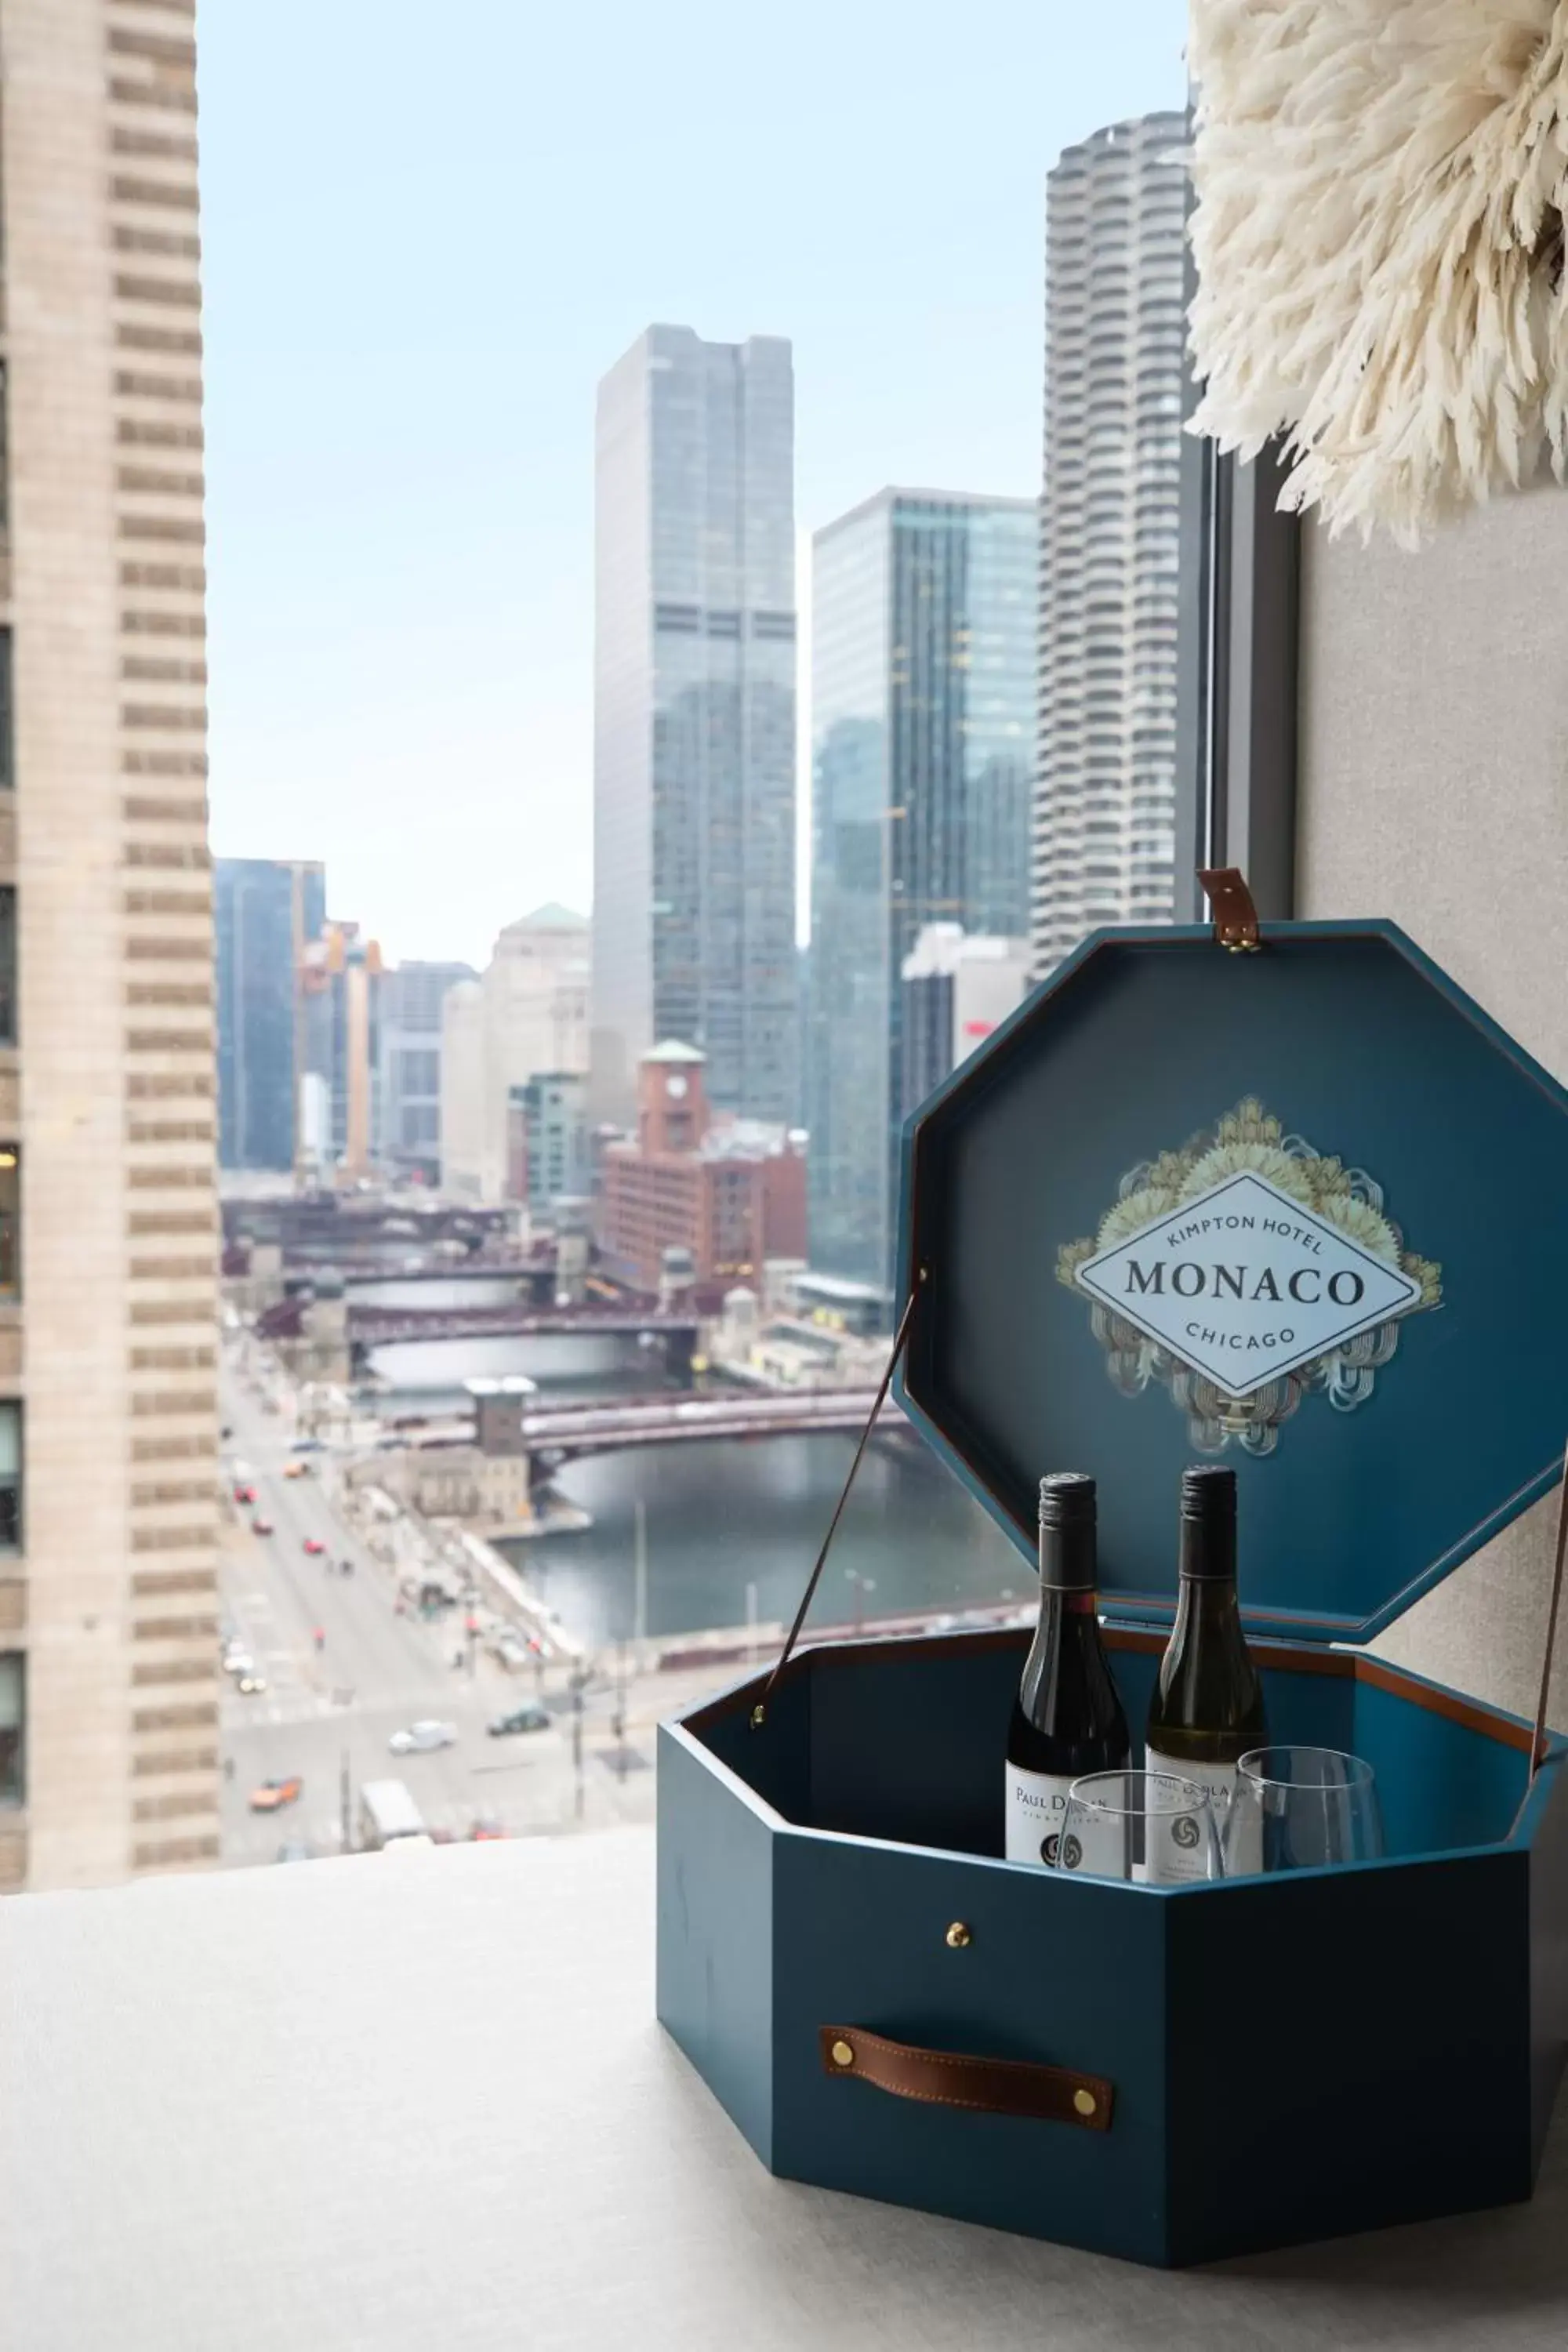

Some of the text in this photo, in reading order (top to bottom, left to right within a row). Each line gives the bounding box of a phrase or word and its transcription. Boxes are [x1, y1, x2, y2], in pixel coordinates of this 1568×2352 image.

[1167, 1216, 1323, 1255] KIMPTON HOTEL
[1123, 1260, 1365, 1306] MONACO
[1185, 1322, 1295, 1350] CHICAGO
[1015, 1787, 1047, 1809] PAUL
